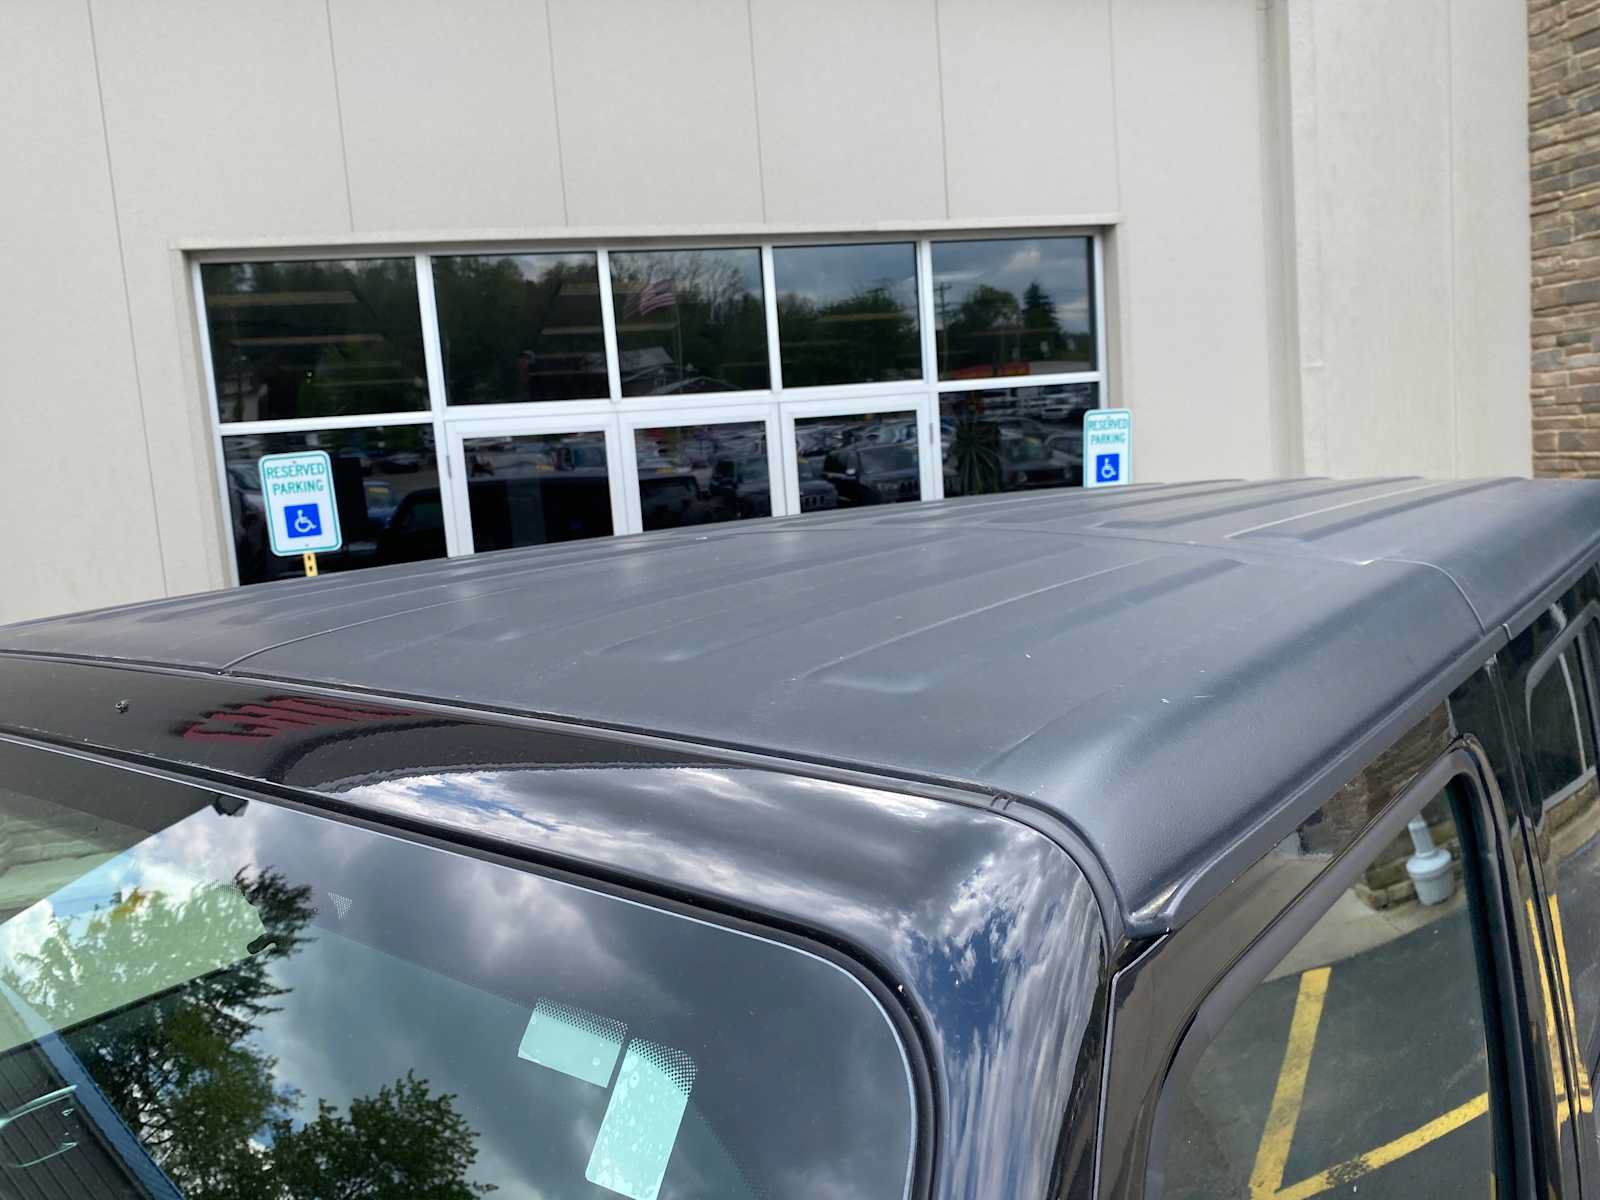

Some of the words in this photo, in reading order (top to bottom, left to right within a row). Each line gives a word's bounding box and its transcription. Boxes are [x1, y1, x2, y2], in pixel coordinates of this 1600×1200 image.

[1087, 418, 1128, 431] RESERVED
[1091, 432, 1125, 445] PARKING
[265, 463, 325, 479] RESERVED
[272, 479, 324, 495] PARKING
